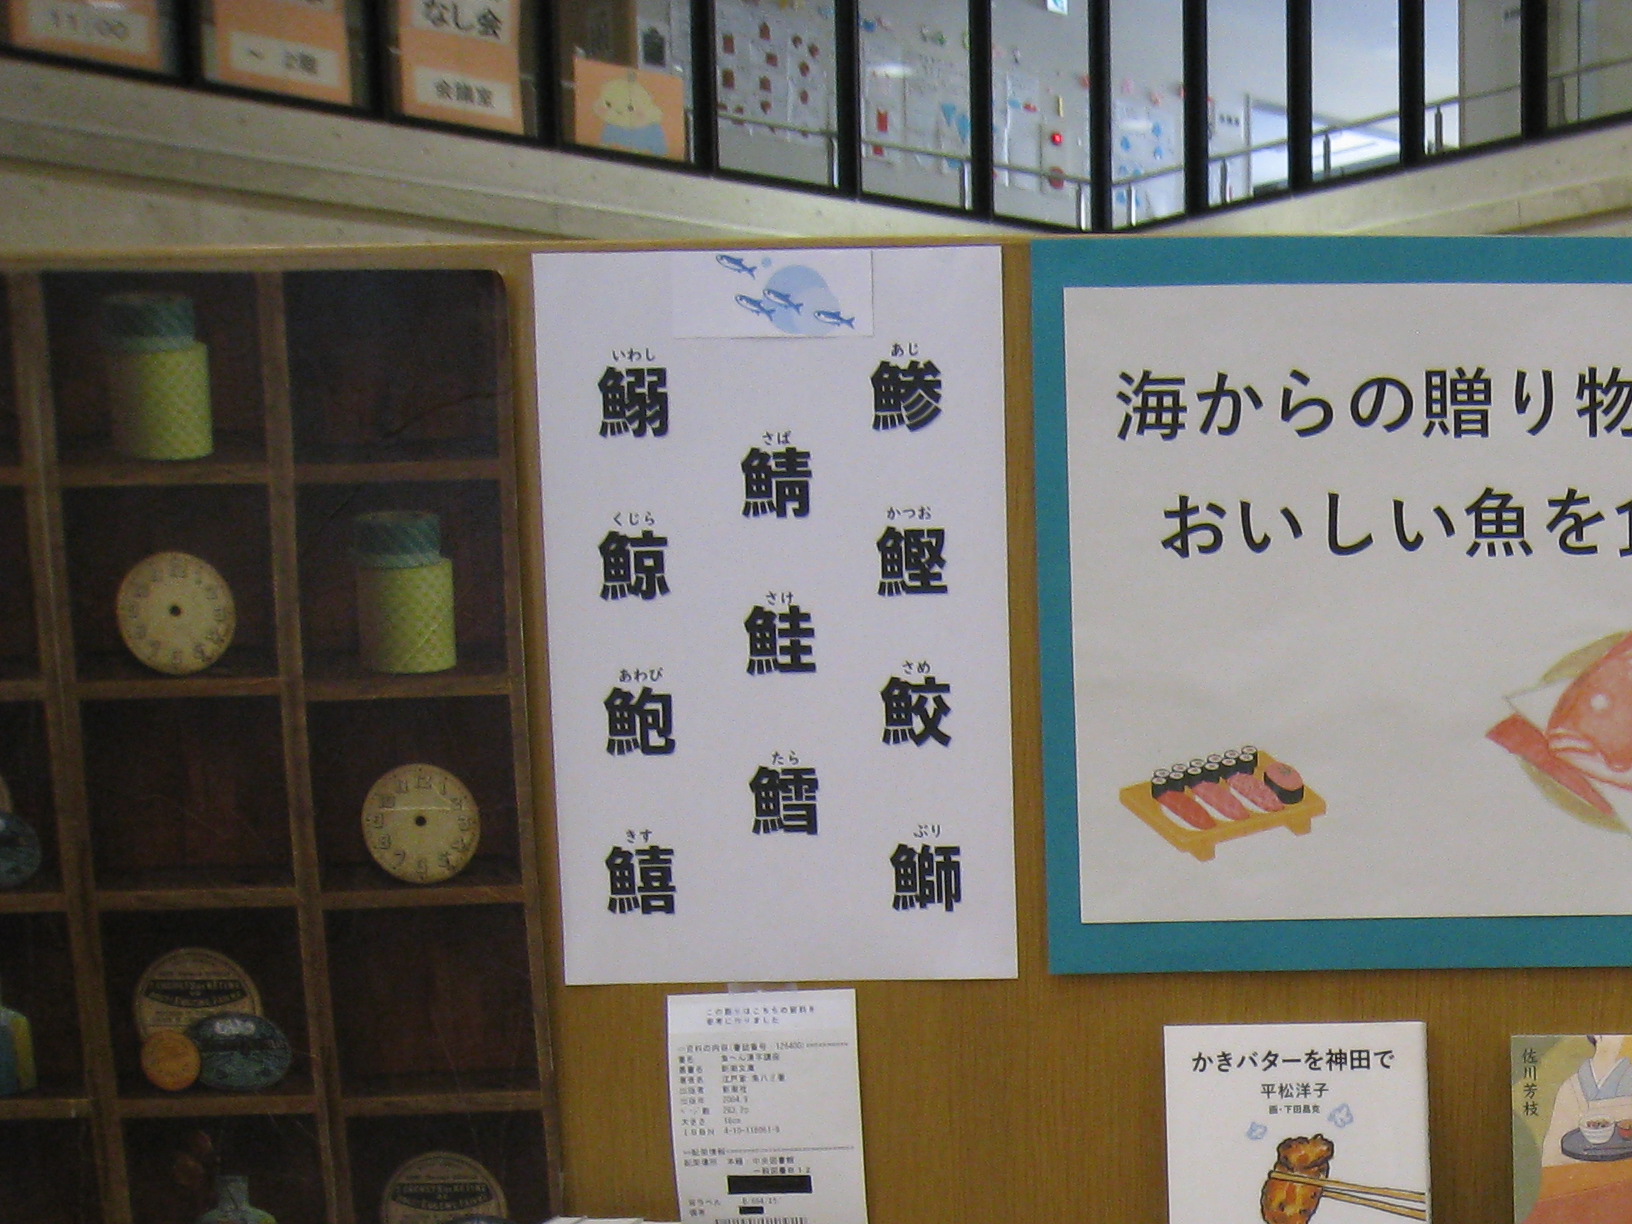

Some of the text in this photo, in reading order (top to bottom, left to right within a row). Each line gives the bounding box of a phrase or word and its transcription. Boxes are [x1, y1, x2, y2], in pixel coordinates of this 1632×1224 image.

[612, 348, 656, 362] いわし
[891, 343, 919, 356] あじ
[598, 366, 668, 438] 鰯
[762, 431, 791, 444] さば
[741, 447, 812, 518] 鯖
[613, 512, 656, 526] くじら
[887, 507, 931, 520] かつお
[598, 530, 669, 600] 鯨
[876, 526, 947, 597] 鰹
[766, 591, 793, 605] さけ
[744, 604, 817, 675] 鮭
[619, 668, 663, 682] あわび
[902, 661, 930, 674] さめ
[604, 686, 675, 755] 鮑
[880, 676, 951, 747] 鮫
[771, 751, 799, 764] たら
[749, 766, 818, 835] 鱈
[625, 829, 653, 843] きす
[913, 824, 941, 838] ぶり
[605, 846, 676, 914] 鱚
[890, 843, 961, 912] 鰤
[1192, 1049, 1395, 1074] かきバターを神田で
[1260, 1083, 1330, 1099] 平松洋子
[1522, 1047, 1540, 1117] 佐川芳枝
